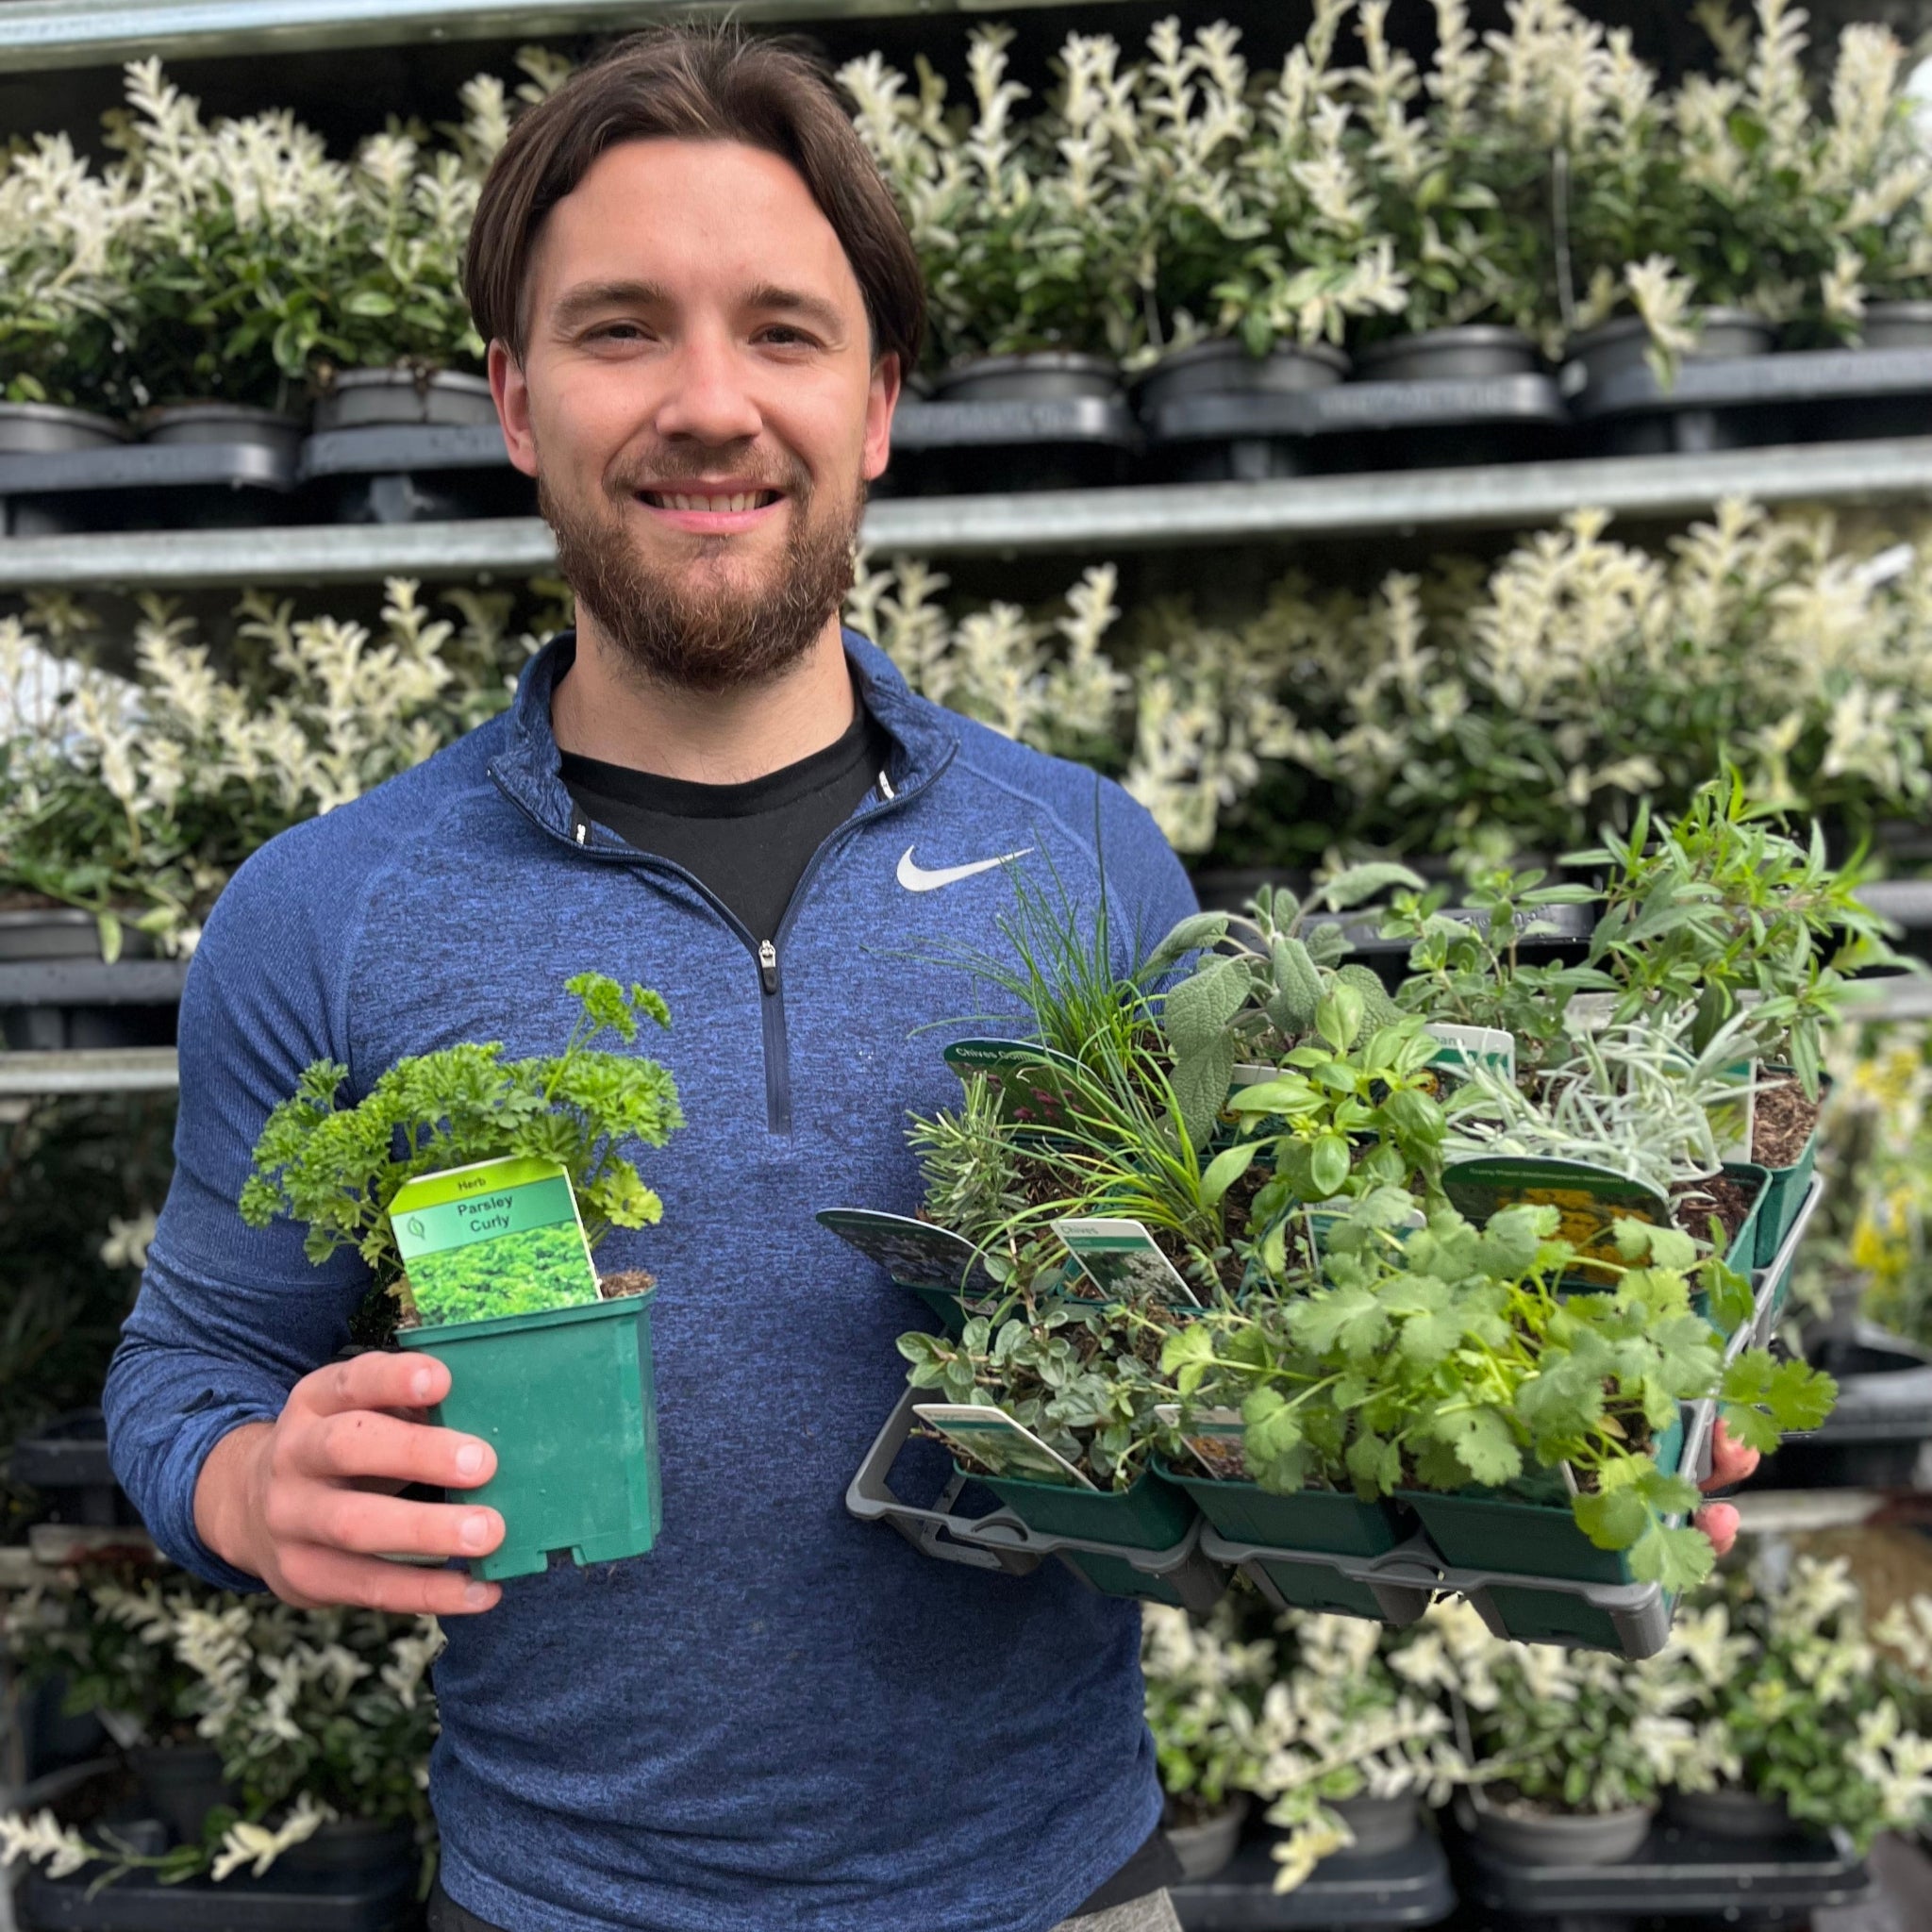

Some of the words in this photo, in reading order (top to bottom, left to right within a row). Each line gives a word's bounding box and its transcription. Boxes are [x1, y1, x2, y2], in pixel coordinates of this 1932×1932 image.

[955, 1047, 997, 1059] Chives
[458, 1177, 487, 1191] Herb
[458, 1194, 513, 1216] Parsley
[470, 1215, 510, 1232] Curly
[1060, 1225, 1099, 1235] Chives
